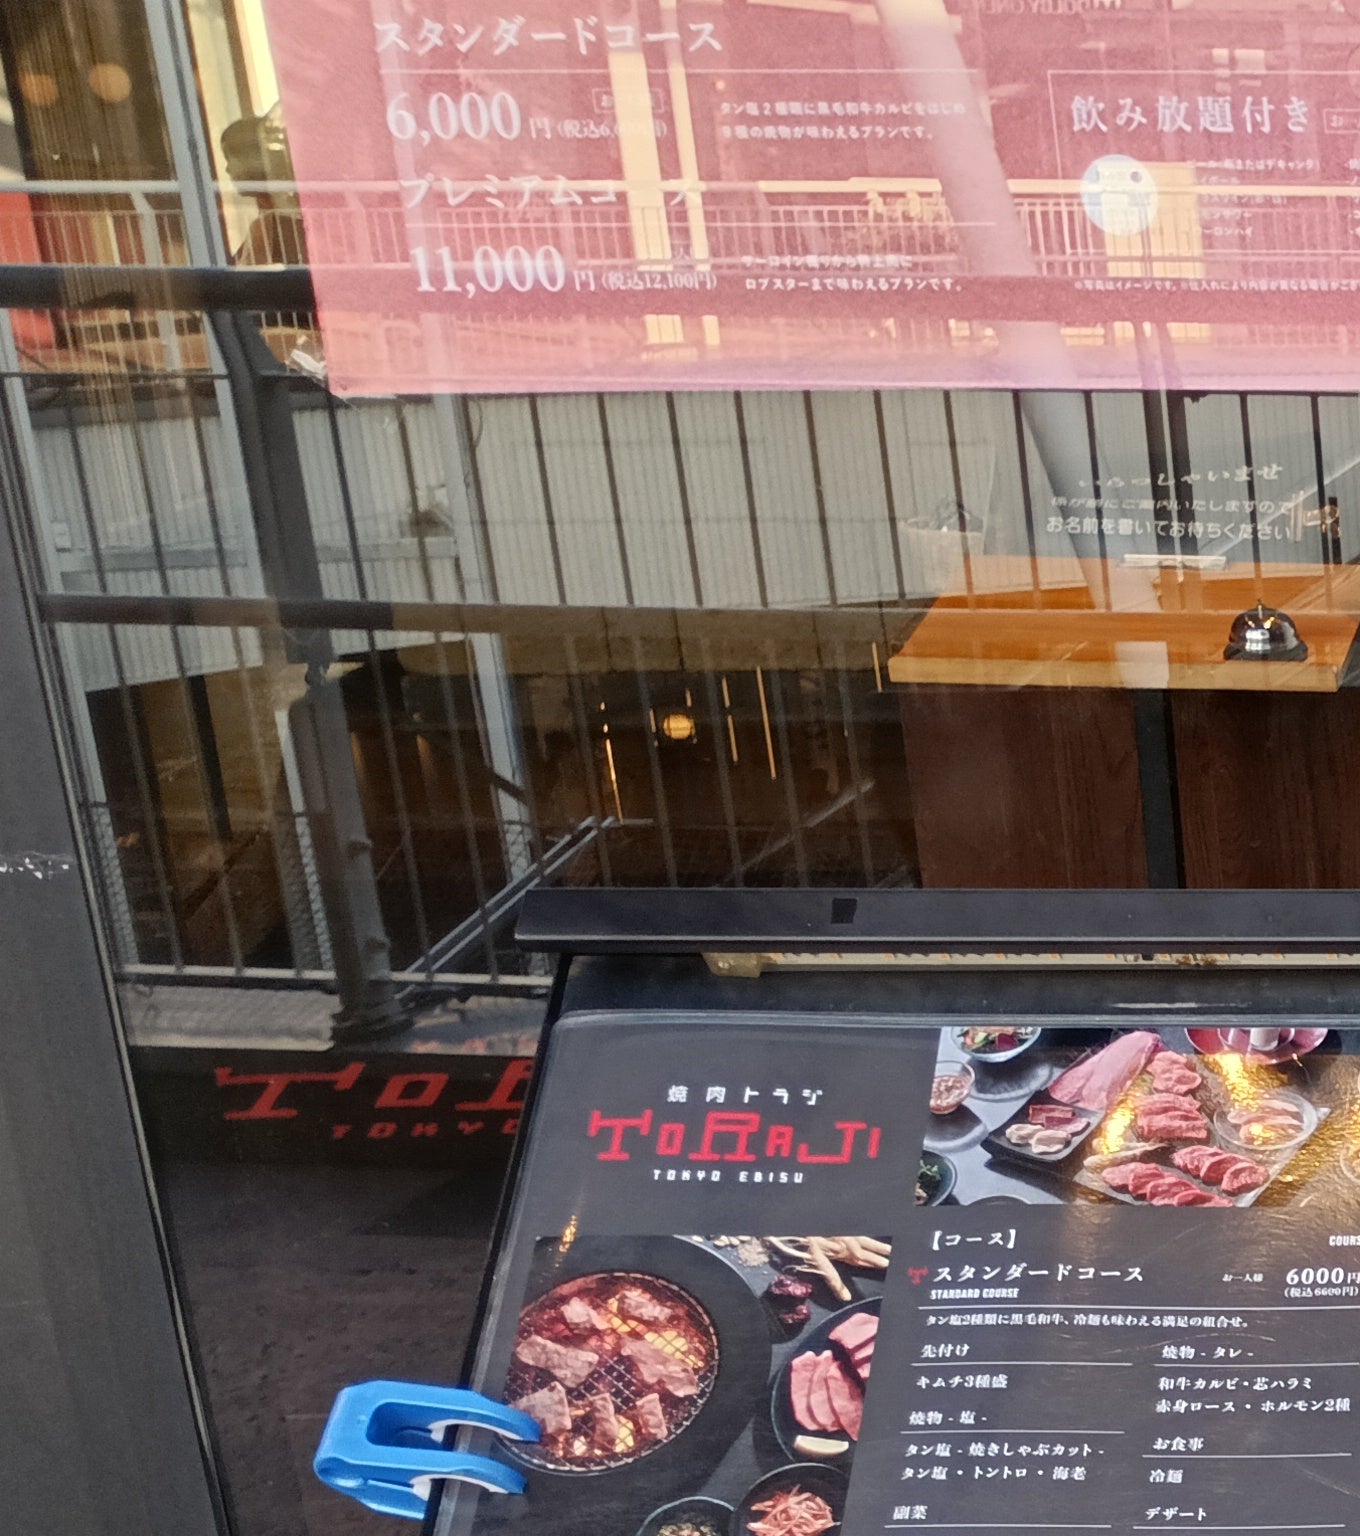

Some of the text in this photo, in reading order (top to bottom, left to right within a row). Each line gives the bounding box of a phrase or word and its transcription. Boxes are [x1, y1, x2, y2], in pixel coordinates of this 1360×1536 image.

[374, 14, 722, 55] スタンダードコース
[1070, 94, 1310, 135] 飲み放題付き
[400, 172, 708, 209] プレミアムコス
[1046, 516, 1293, 541] お名前を書いてお待ちください
[666, 1084, 823, 1106] 焼肉トラジ
[587, 1108, 881, 1164] TORAJI
[653, 1168, 804, 1184] TOKYO EBISU
[932, 1228, 1017, 1251] 【コース】
[933, 1262, 1143, 1282] スタンダードコース
[929, 1287, 1020, 1300] STANDARD COURSE
[920, 1343, 970, 1358] 先付け
[916, 1373, 1009, 1389] キムチ3種盛
[1152, 1436, 1204, 1452] お食事
[1149, 1468, 1184, 1484] 冷麺
[892, 1504, 928, 1521] 副菜
[1145, 1506, 1207, 1522] デザート
